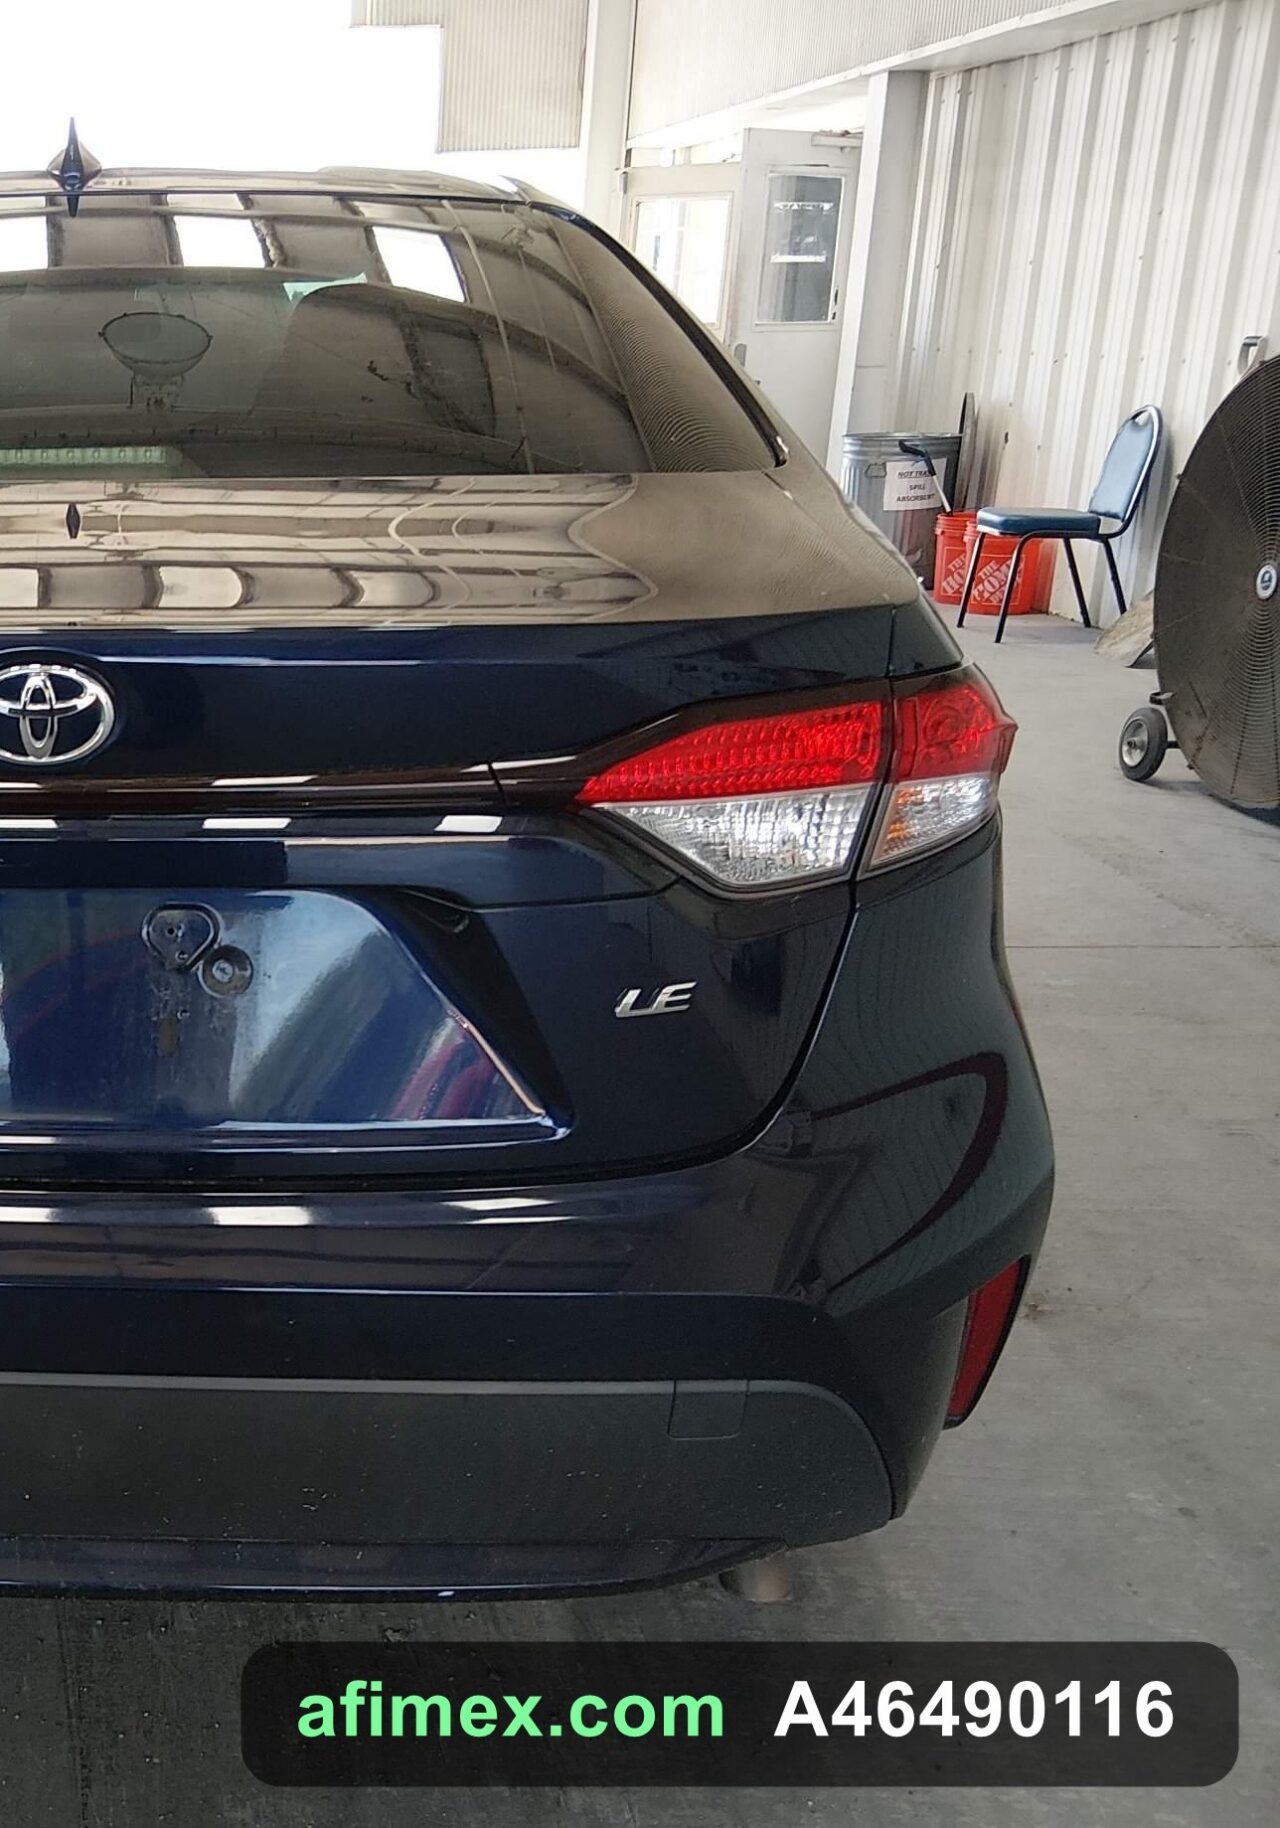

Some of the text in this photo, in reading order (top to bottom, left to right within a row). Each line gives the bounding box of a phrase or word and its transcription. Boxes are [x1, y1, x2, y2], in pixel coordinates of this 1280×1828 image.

[898, 470, 915, 479] NOT
[896, 493, 936, 502] ABSORBENT
[978, 560, 1000, 580] THE
[614, 981, 697, 1018] LE
